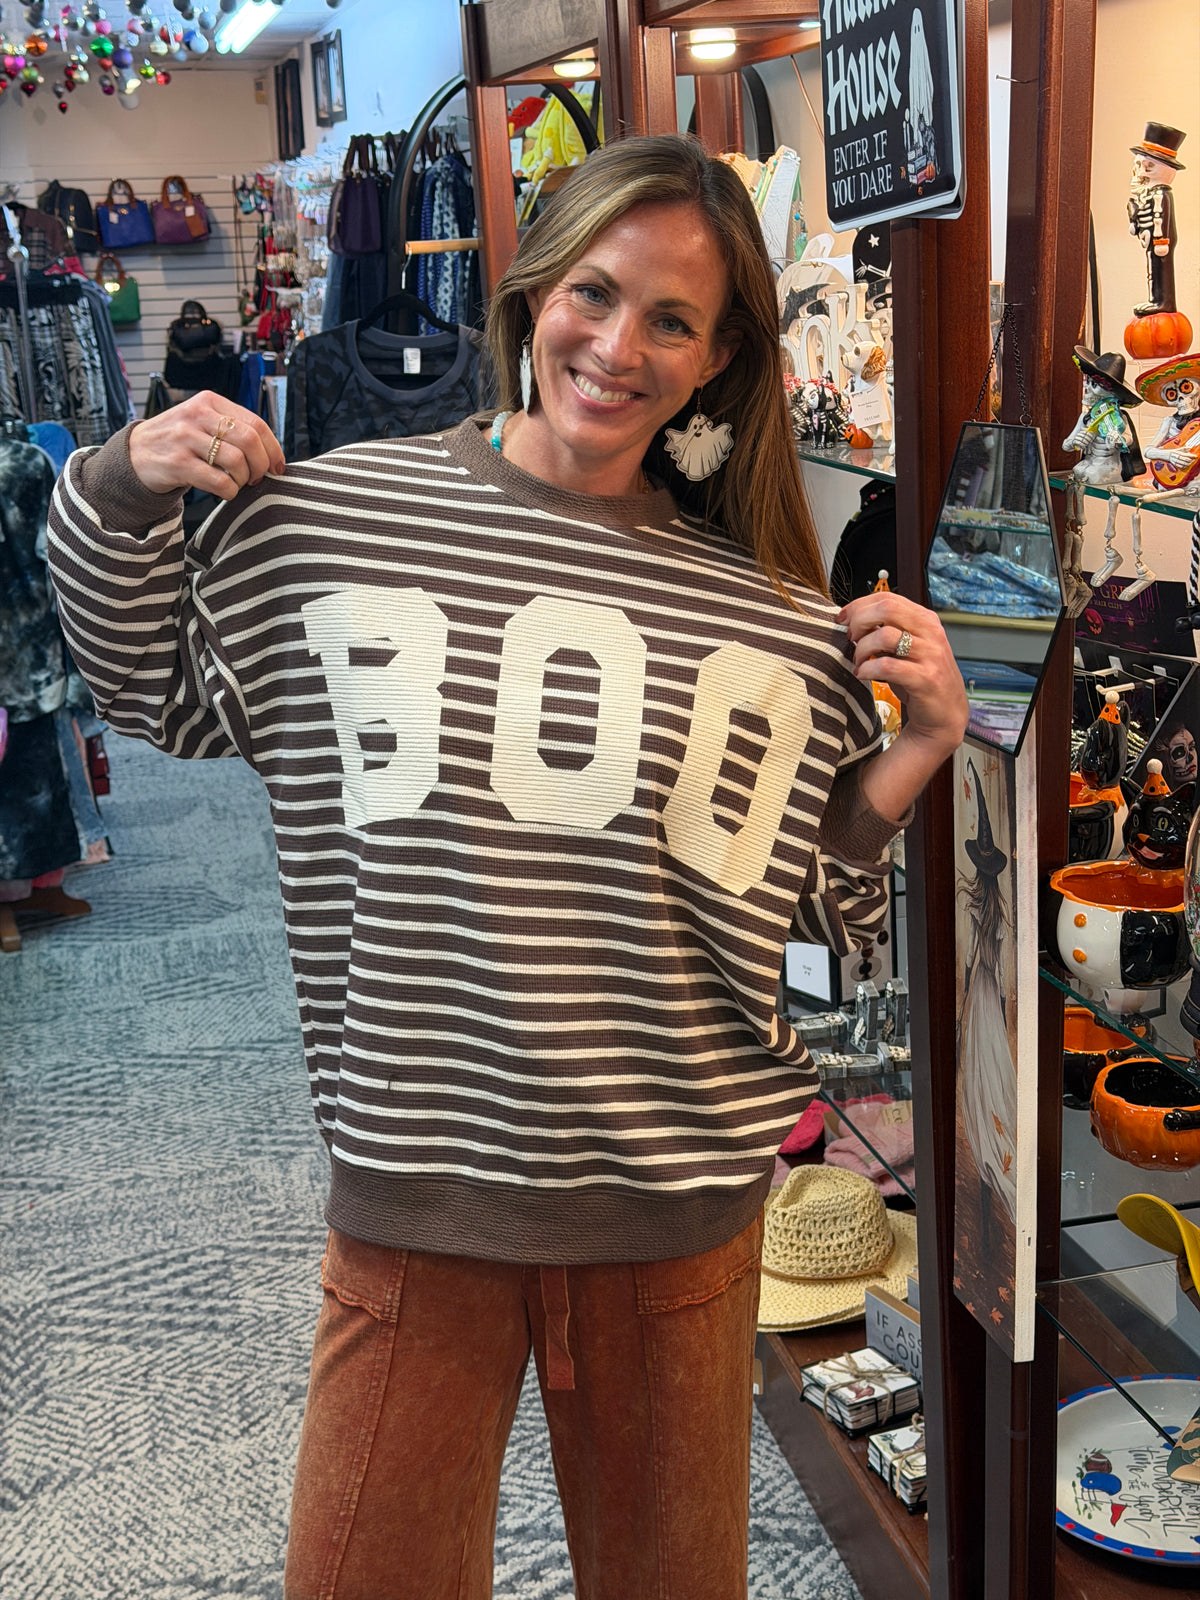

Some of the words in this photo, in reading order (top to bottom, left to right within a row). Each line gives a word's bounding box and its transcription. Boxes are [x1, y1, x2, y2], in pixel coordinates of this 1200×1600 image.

[833, 137, 870, 175] ENTER
[873, 129, 888, 161] IF
[832, 174, 856, 208] YOU
[860, 163, 893, 200] DARE
[301, 587, 813, 896] BOO
[877, 1310, 888, 1328] IF
